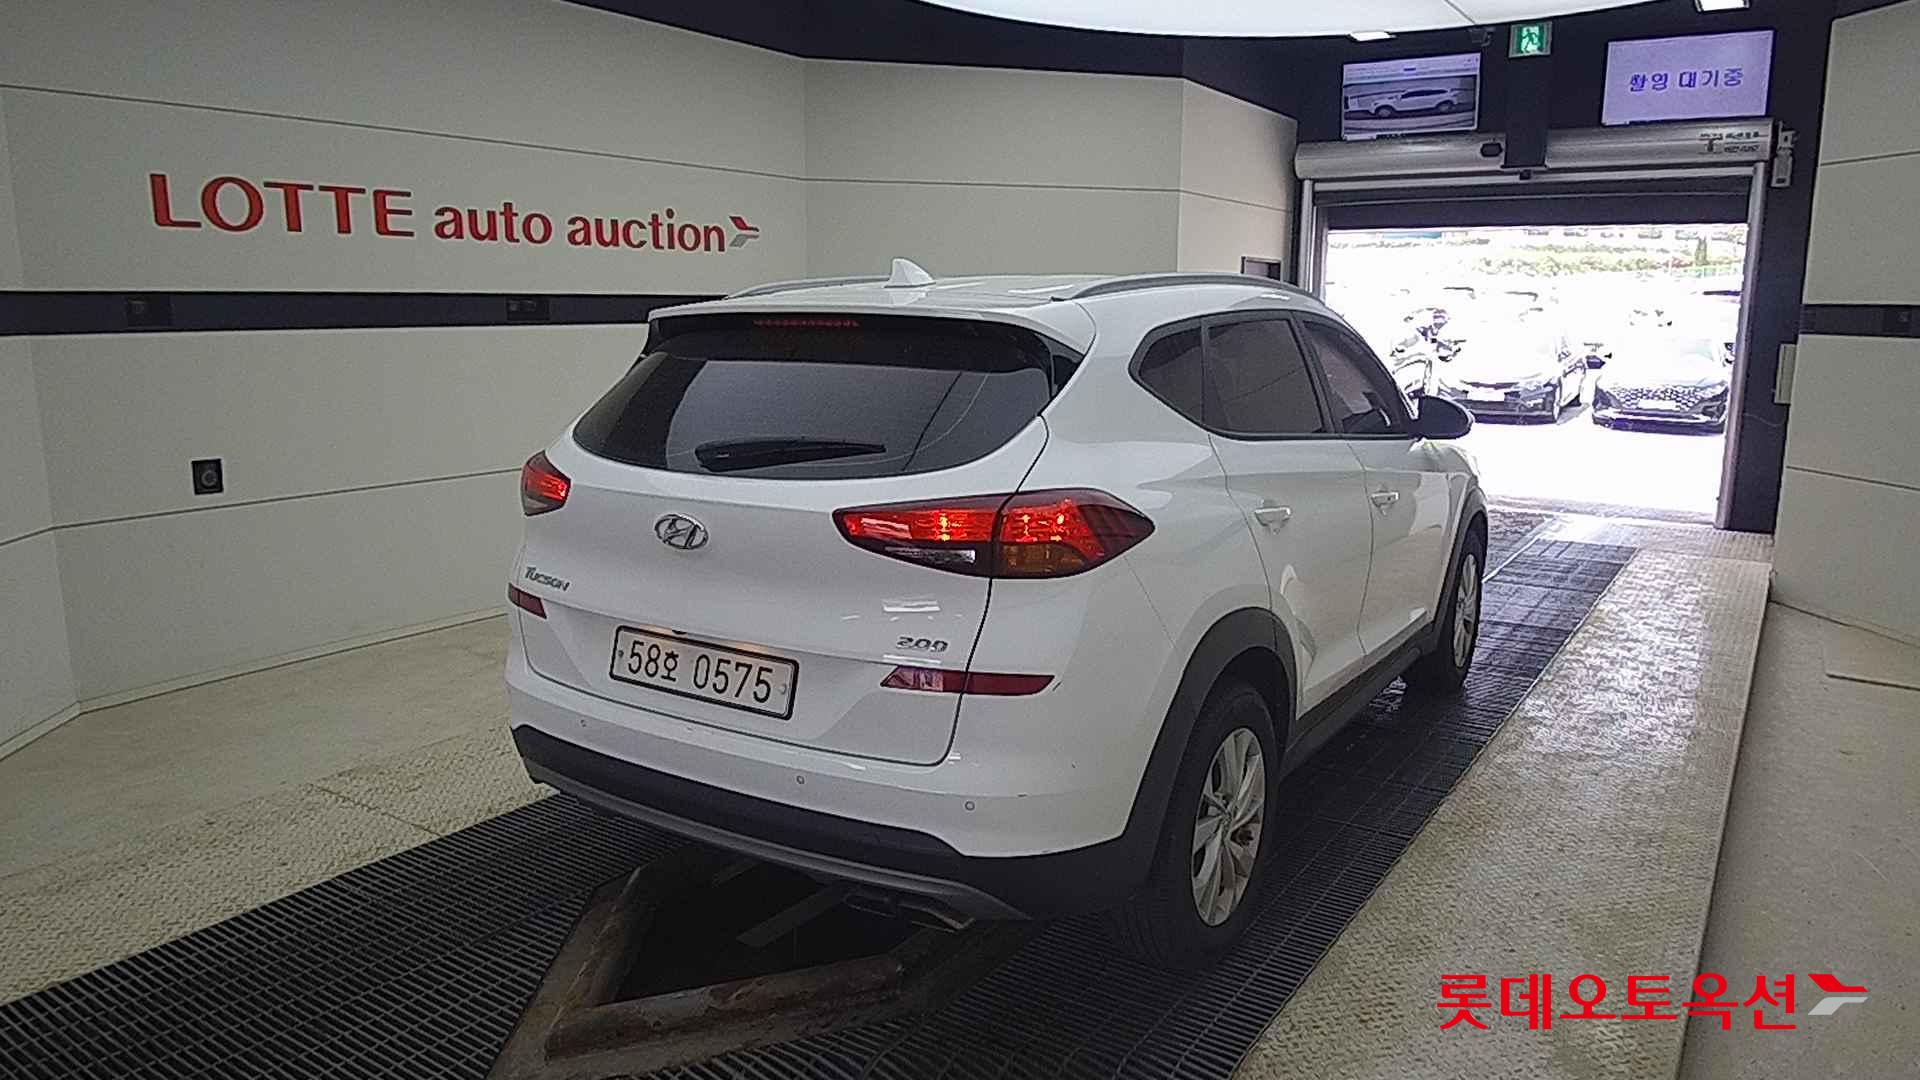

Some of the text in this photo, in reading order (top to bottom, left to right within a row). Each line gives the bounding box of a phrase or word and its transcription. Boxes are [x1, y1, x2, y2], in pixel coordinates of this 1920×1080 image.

[1679, 68, 1744, 88] 대기중
[149, 173, 726, 253] LOTTE auto auction
[627, 640, 773, 704] 58호 0575
